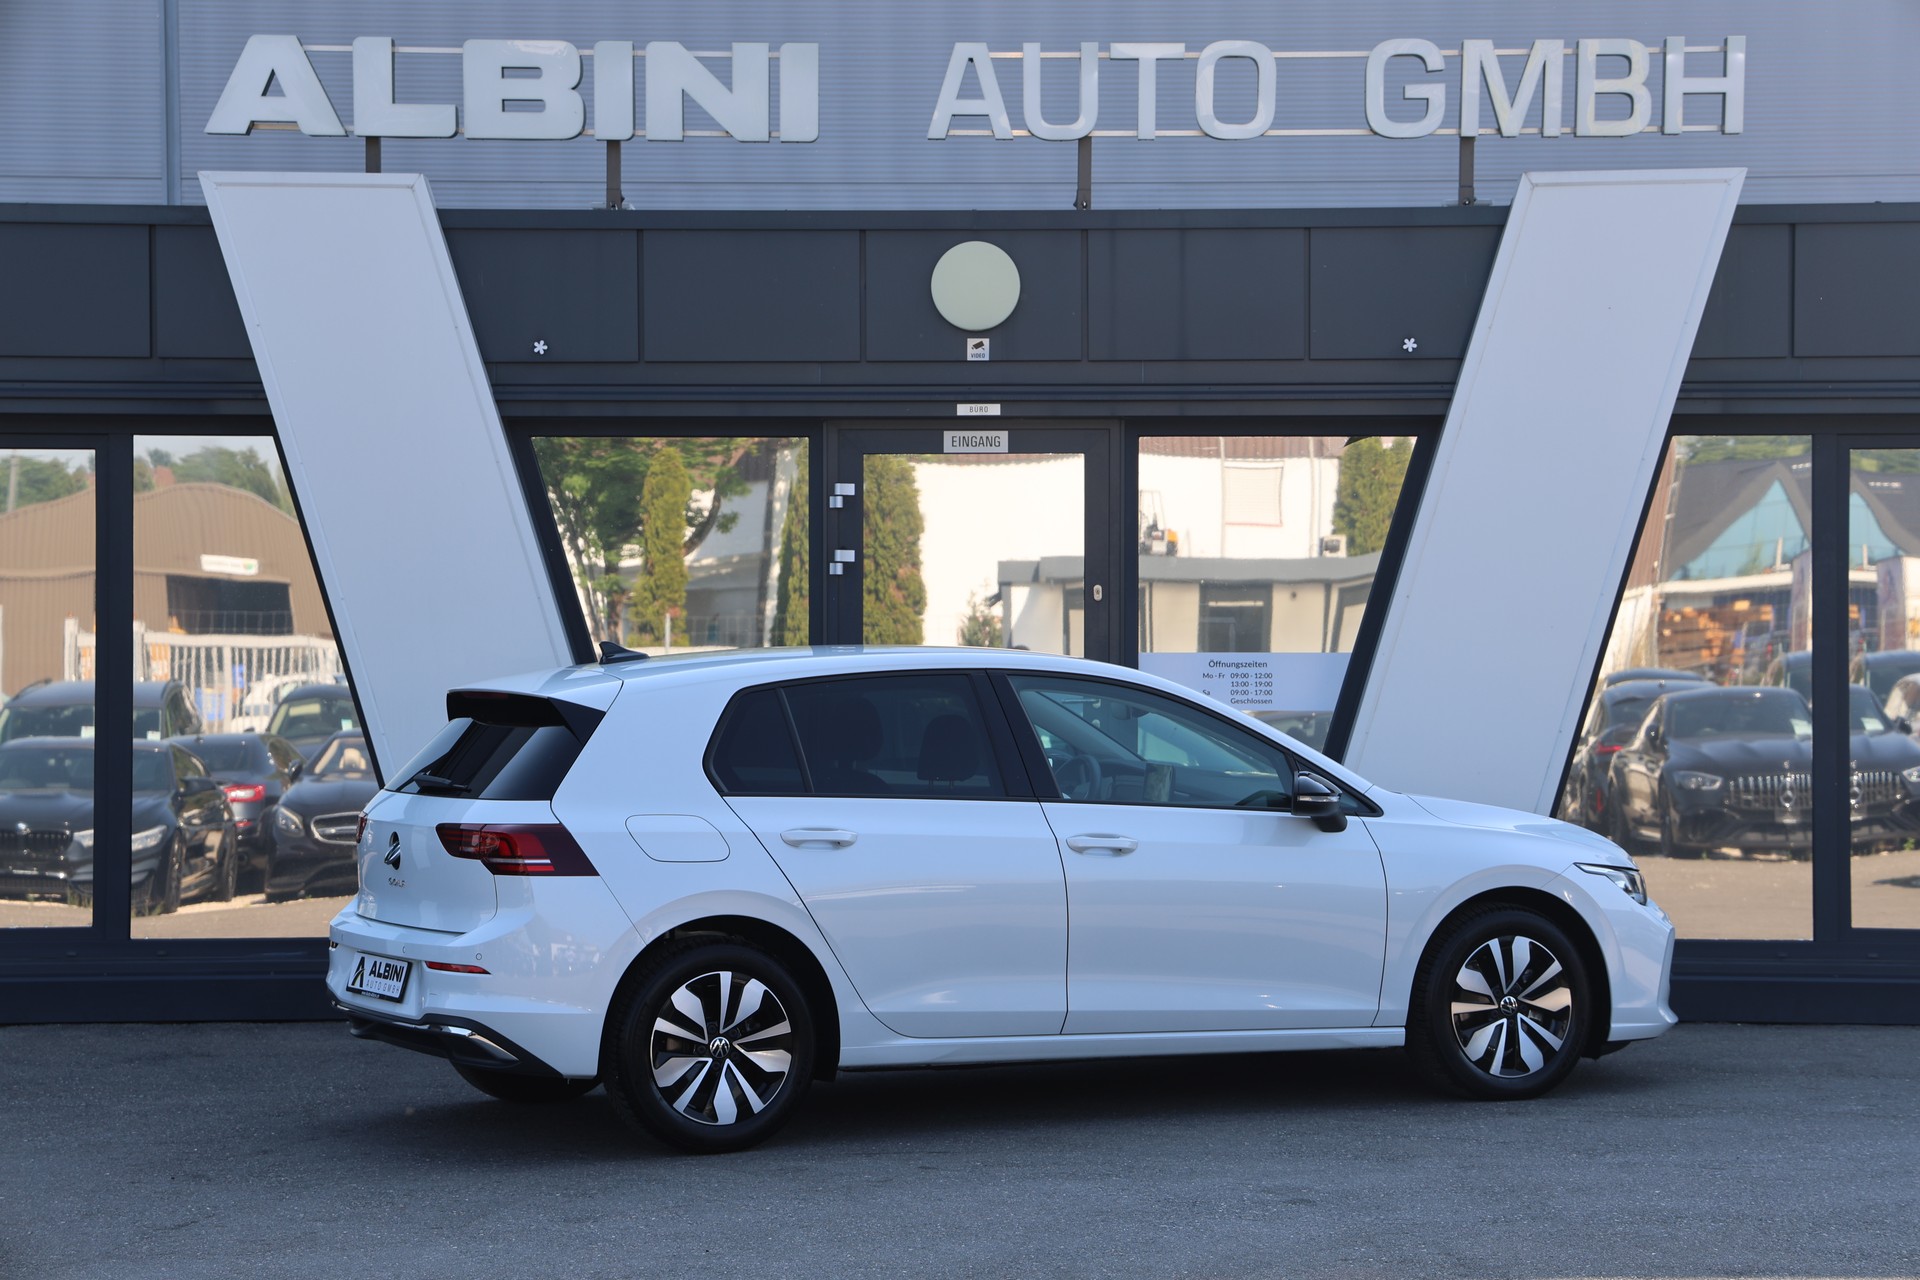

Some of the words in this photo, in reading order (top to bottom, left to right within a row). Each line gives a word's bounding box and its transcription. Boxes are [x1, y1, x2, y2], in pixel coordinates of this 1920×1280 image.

[203, 34, 819, 142] ALBINI
[926, 39, 1277, 141] AUTO
[1364, 35, 1747, 139] GMBH
[969, 404, 989, 413] BÜRO
[951, 435, 1001, 448] EINGANG
[1208, 659, 1268, 669] Öffnungszeiten
[369, 960, 405, 983] ALBINI
[366, 979, 382, 991] AUTO
